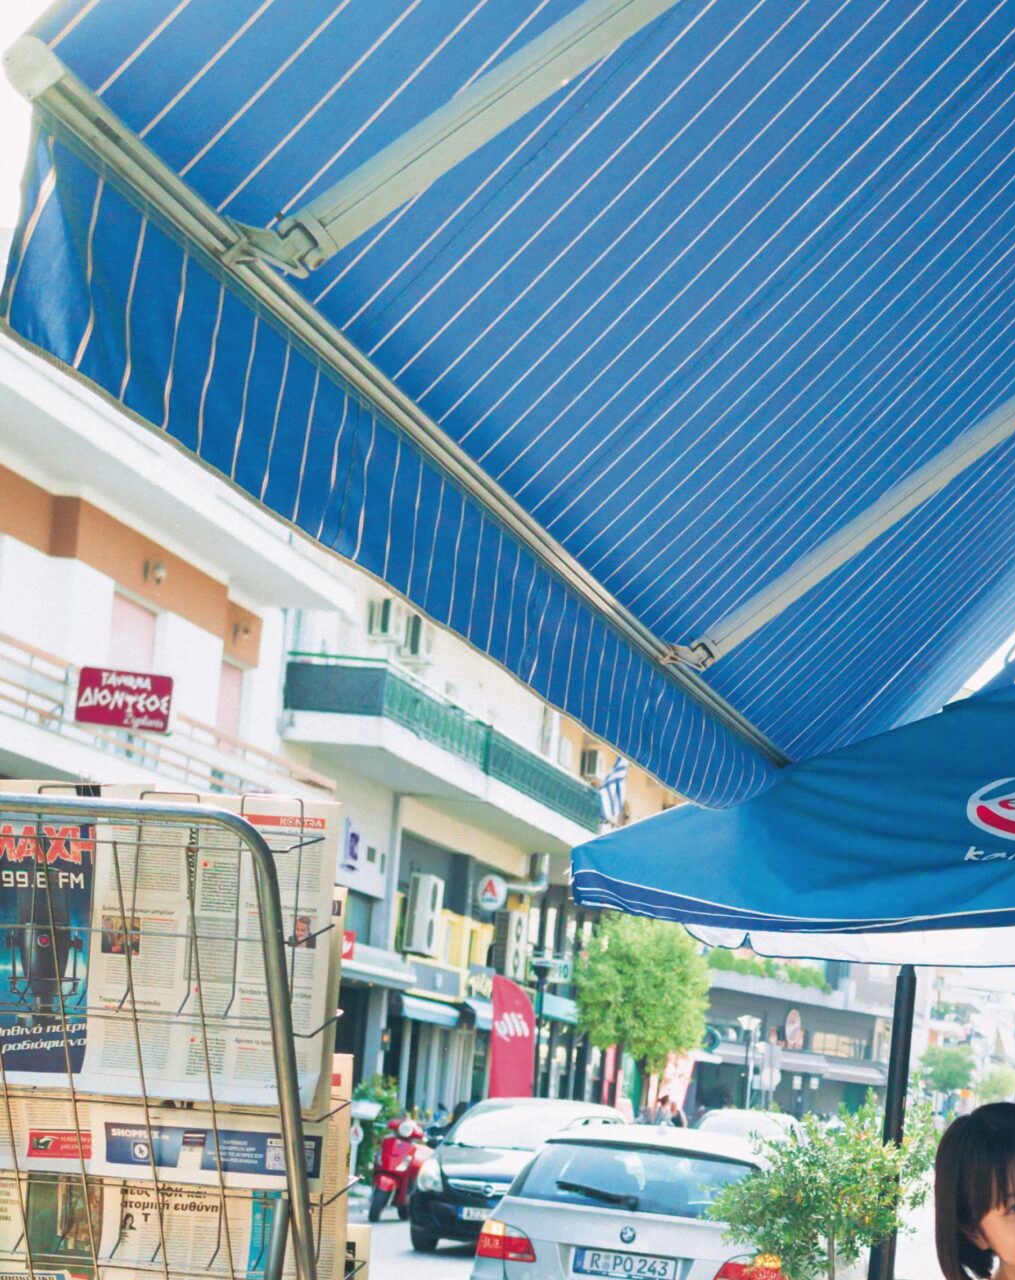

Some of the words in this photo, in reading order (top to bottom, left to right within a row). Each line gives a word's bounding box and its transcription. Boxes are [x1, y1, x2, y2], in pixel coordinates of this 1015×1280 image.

[58, 872, 85, 889] FM
[590, 1253, 600, 1269] R
[636, 1259, 669, 1276] 243
